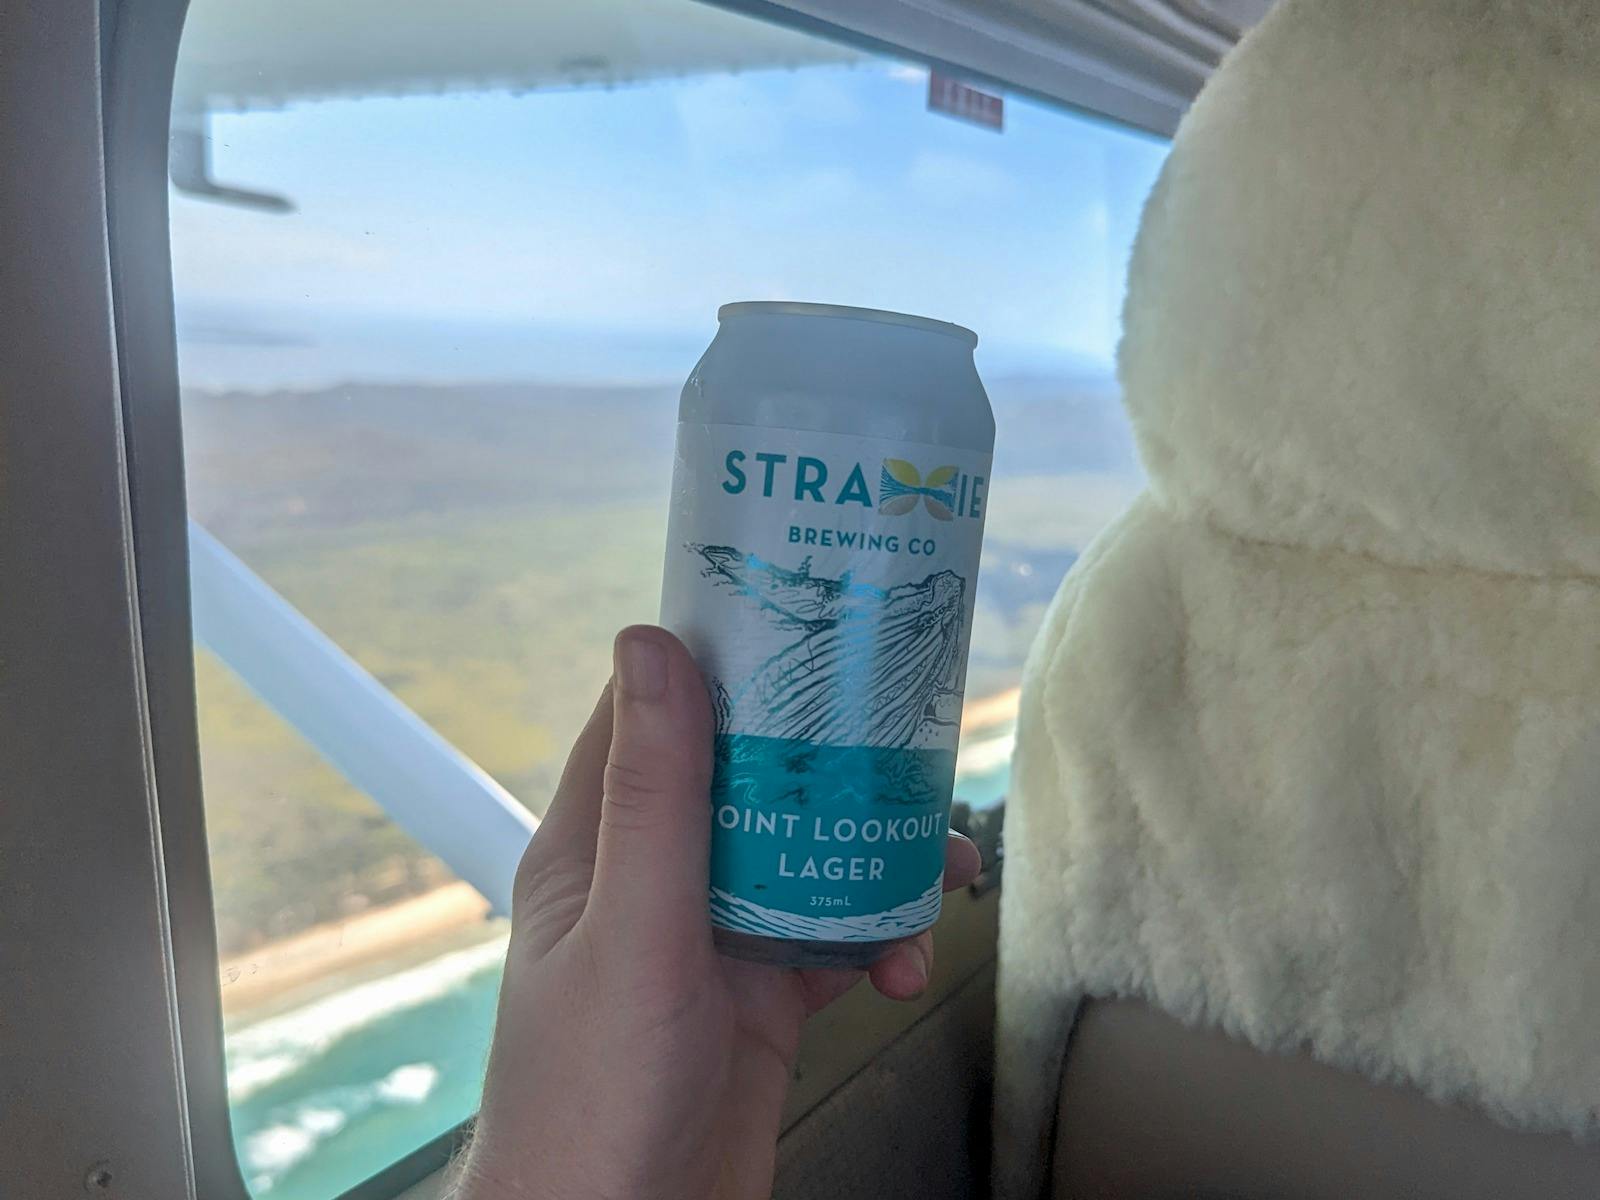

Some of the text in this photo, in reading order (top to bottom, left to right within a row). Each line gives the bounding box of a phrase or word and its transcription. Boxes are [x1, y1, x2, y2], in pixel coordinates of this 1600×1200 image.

[788, 526, 936, 556] BREWING CO
[710, 802, 943, 843] OINT LOOKOUT
[778, 853, 885, 881] LAGER
[809, 895, 852, 907] 375mL
